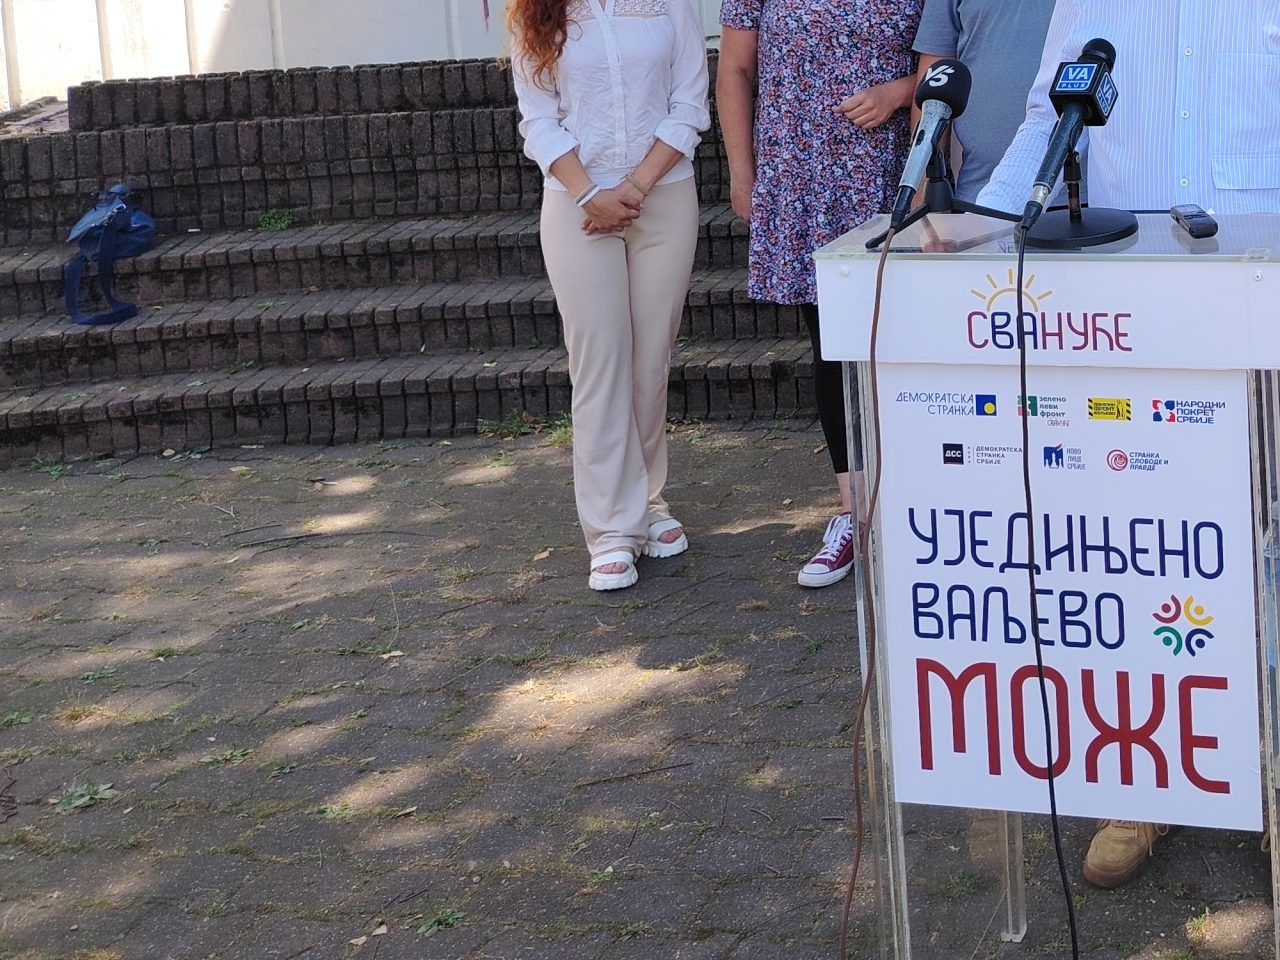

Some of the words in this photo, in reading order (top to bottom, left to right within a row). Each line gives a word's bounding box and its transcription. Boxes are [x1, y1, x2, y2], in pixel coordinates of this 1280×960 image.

[1066, 66, 1090, 81] VA
[1060, 82, 1087, 90] PLUS
[967, 310, 1133, 352] СВАНУЋЕ
[896, 391, 975, 405] ДЕМОКРАТСКА
[1039, 395, 1067, 404] зелено
[1176, 400, 1226, 409] НАРОДНИ
[927, 404, 975, 416] СТРАНКА
[1039, 409, 1067, 419] фронт
[1176, 408, 1216, 417] ПОКРЕТ
[1176, 416, 1215, 425] СРБИЈЕ
[945, 449, 962, 458] ДСС
[975, 445, 1023, 453] ДЕМОКРАТСКА
[1129, 451, 1160, 459] СТРАНКА
[1129, 458, 1163, 466] СЛОБОДЕ
[1129, 464, 1156, 472] ПРАВДЕ
[907, 507, 1225, 580] УЈЕДИЊЕНО
[912, 581, 1126, 651] ВАЉЕВО
[915, 657, 1231, 795] МОЖЕ
